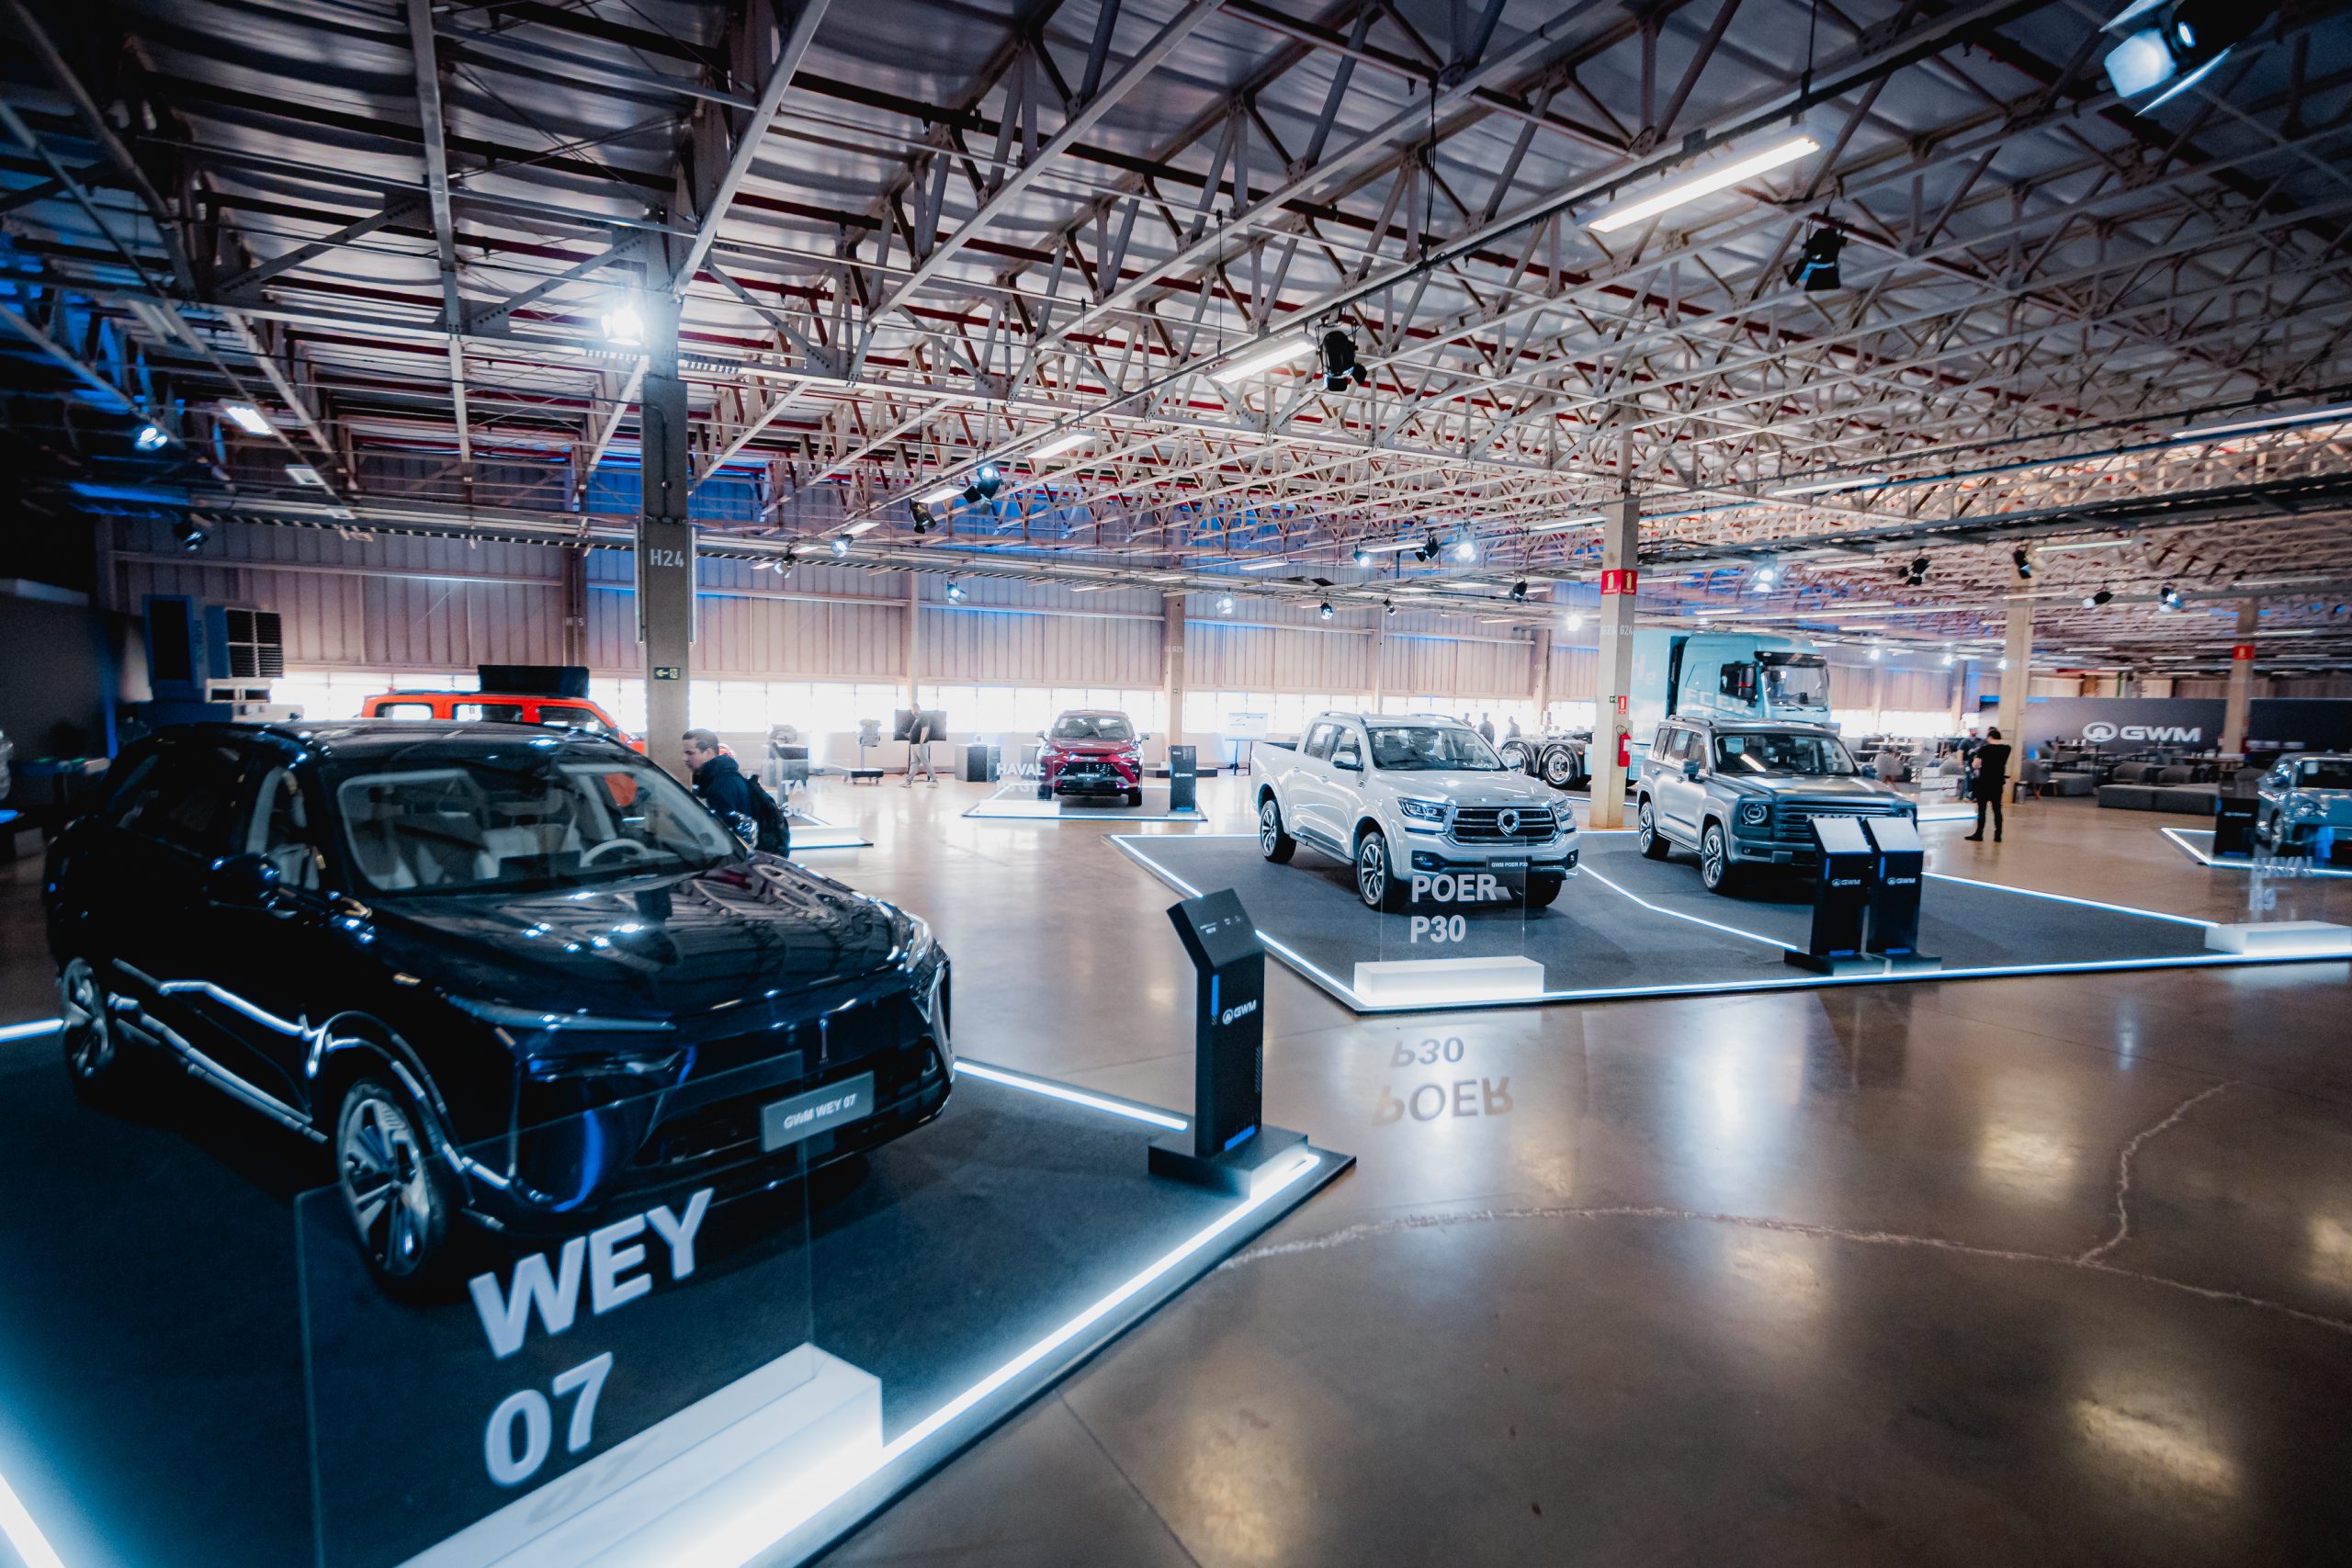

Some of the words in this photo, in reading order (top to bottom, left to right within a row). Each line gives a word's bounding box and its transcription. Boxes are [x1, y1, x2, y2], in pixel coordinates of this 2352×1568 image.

[650, 548, 684, 568] H24
[566, 617, 585, 626] H5
[2120, 725, 2202, 742] GWM
[996, 762, 1046, 776] HAVAL
[1411, 874, 1498, 903] POER
[1410, 915, 1466, 944] P30
[1233, 999, 1257, 1019] GWM
[784, 1108, 815, 1130] GWM
[815, 1097, 842, 1118] WEY
[842, 1092, 857, 1109] 07
[468, 1187, 714, 1359] WEY
[483, 1350, 614, 1487] 07
